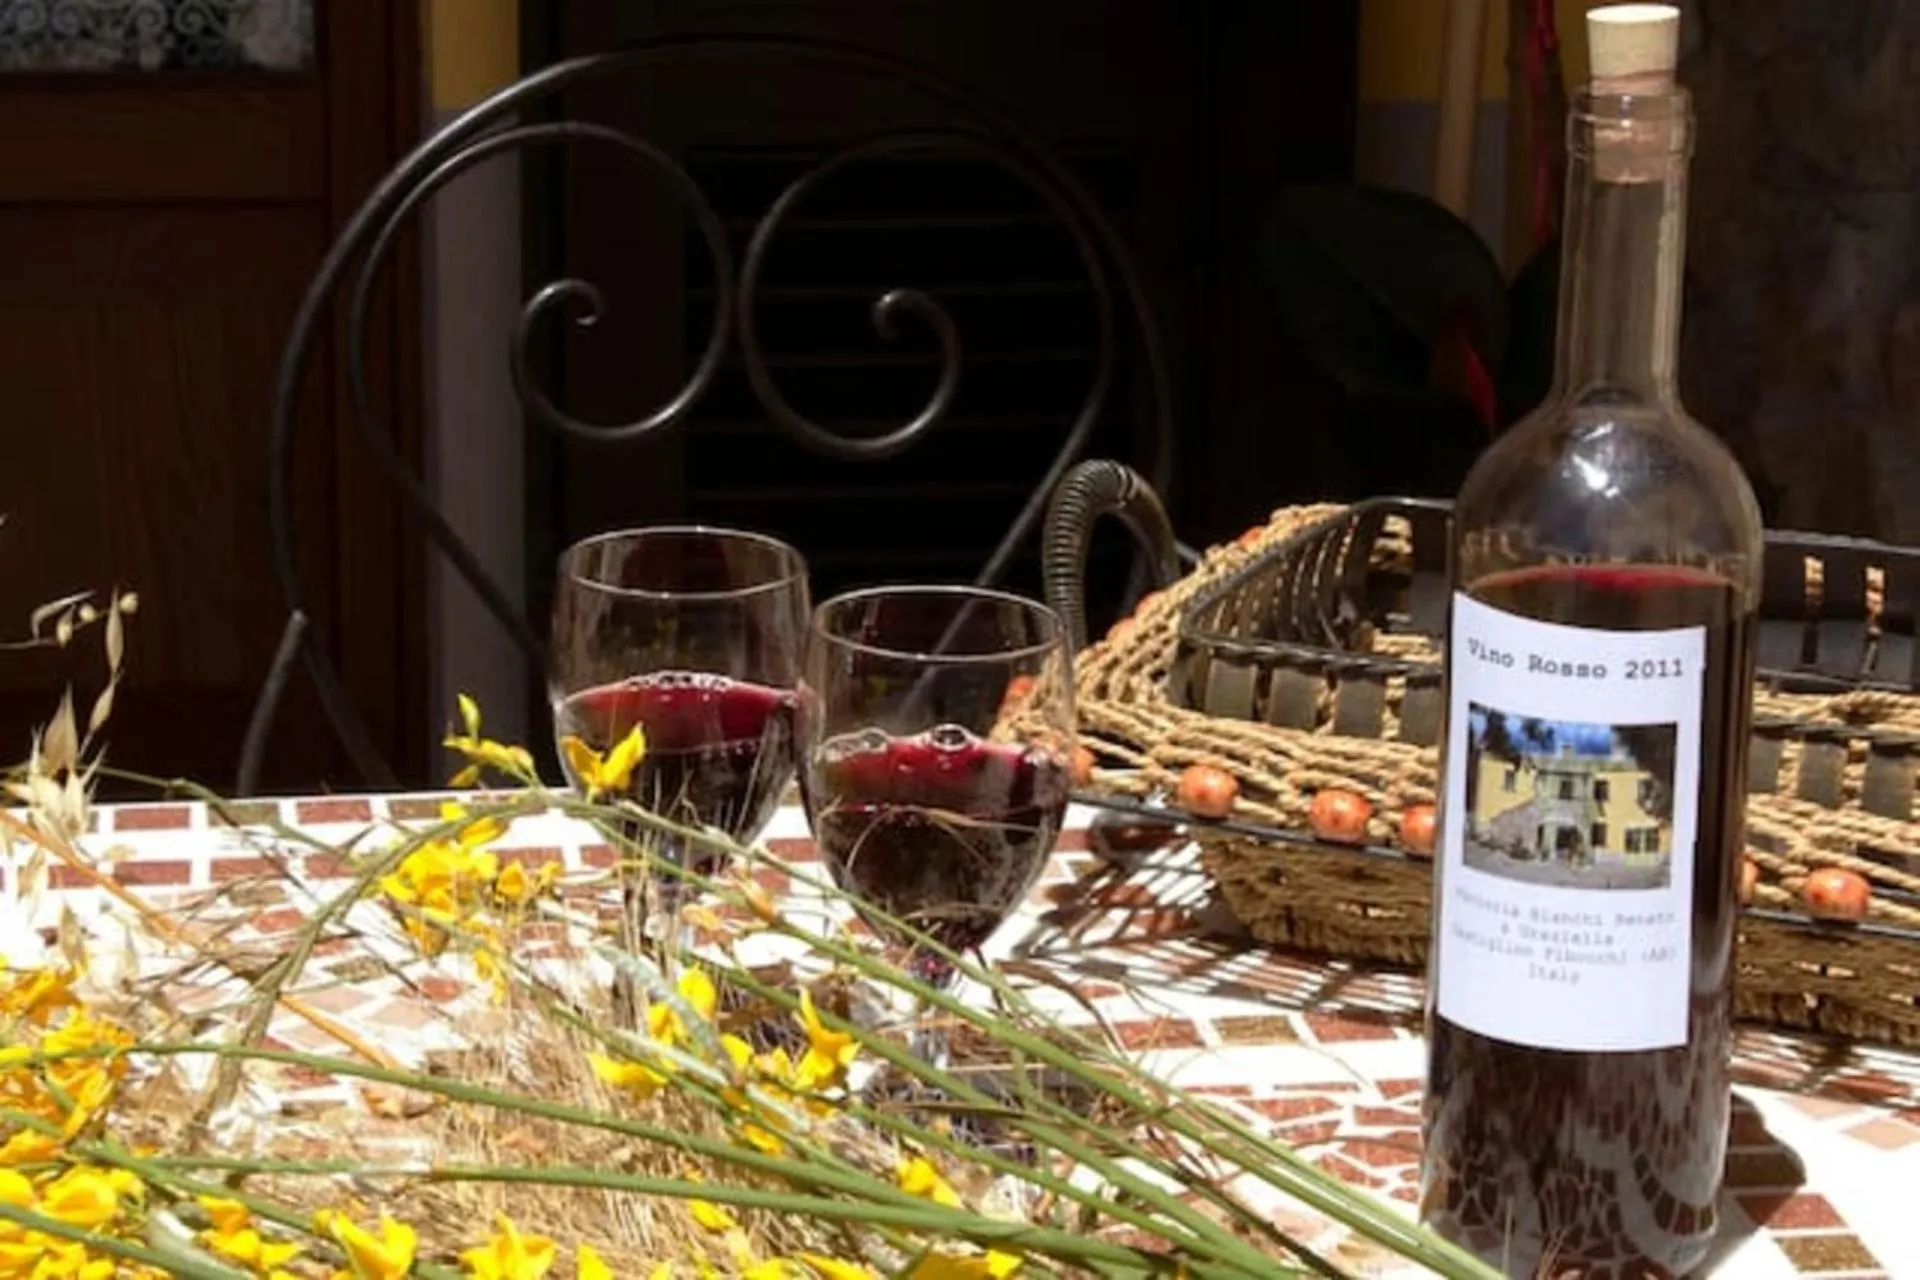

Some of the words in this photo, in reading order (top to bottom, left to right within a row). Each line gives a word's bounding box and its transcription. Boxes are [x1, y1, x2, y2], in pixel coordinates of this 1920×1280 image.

[1467, 637, 1515, 668] Vino
[1528, 654, 1608, 679] Rosso
[1624, 659, 1685, 679] 2011
[1528, 962, 1580, 985] Italy
